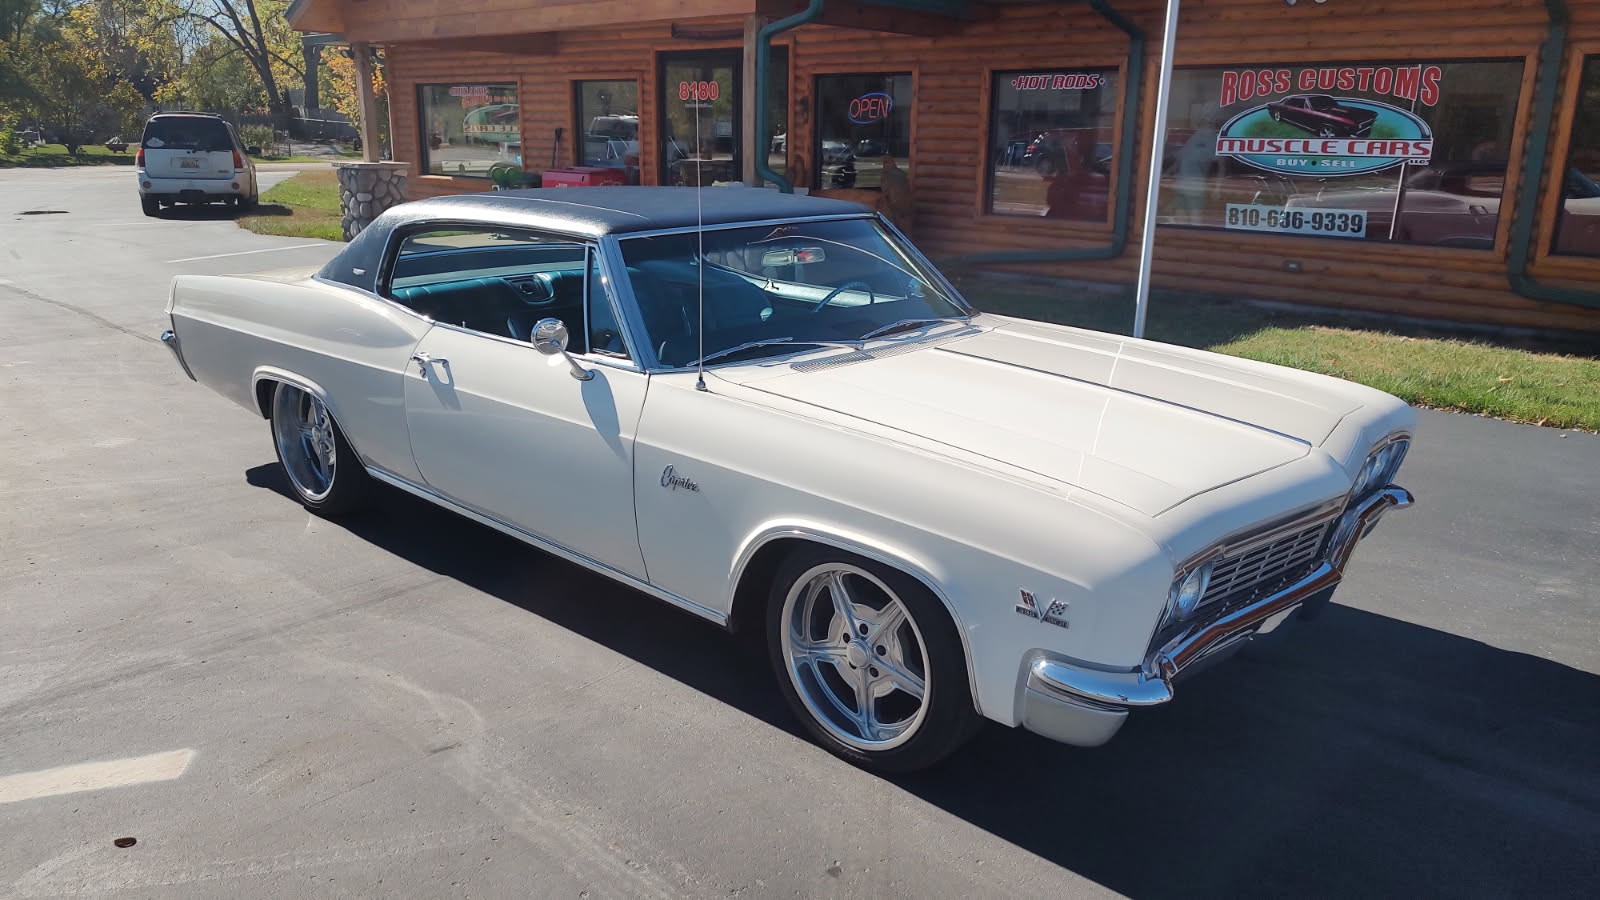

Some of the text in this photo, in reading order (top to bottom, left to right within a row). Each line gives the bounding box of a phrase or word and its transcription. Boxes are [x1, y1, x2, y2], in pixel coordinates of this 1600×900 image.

[679, 81, 719, 100] 8180
[1016, 74, 1099, 90] HOT RODS
[1220, 66, 1442, 108] ROSS CUSTOMS
[850, 98, 889, 119] OPEN
[1217, 138, 1431, 156] MUSCLE CARS
[1277, 159, 1356, 168] BUY SELL
[1228, 207, 1364, 233] 810-636-9339
